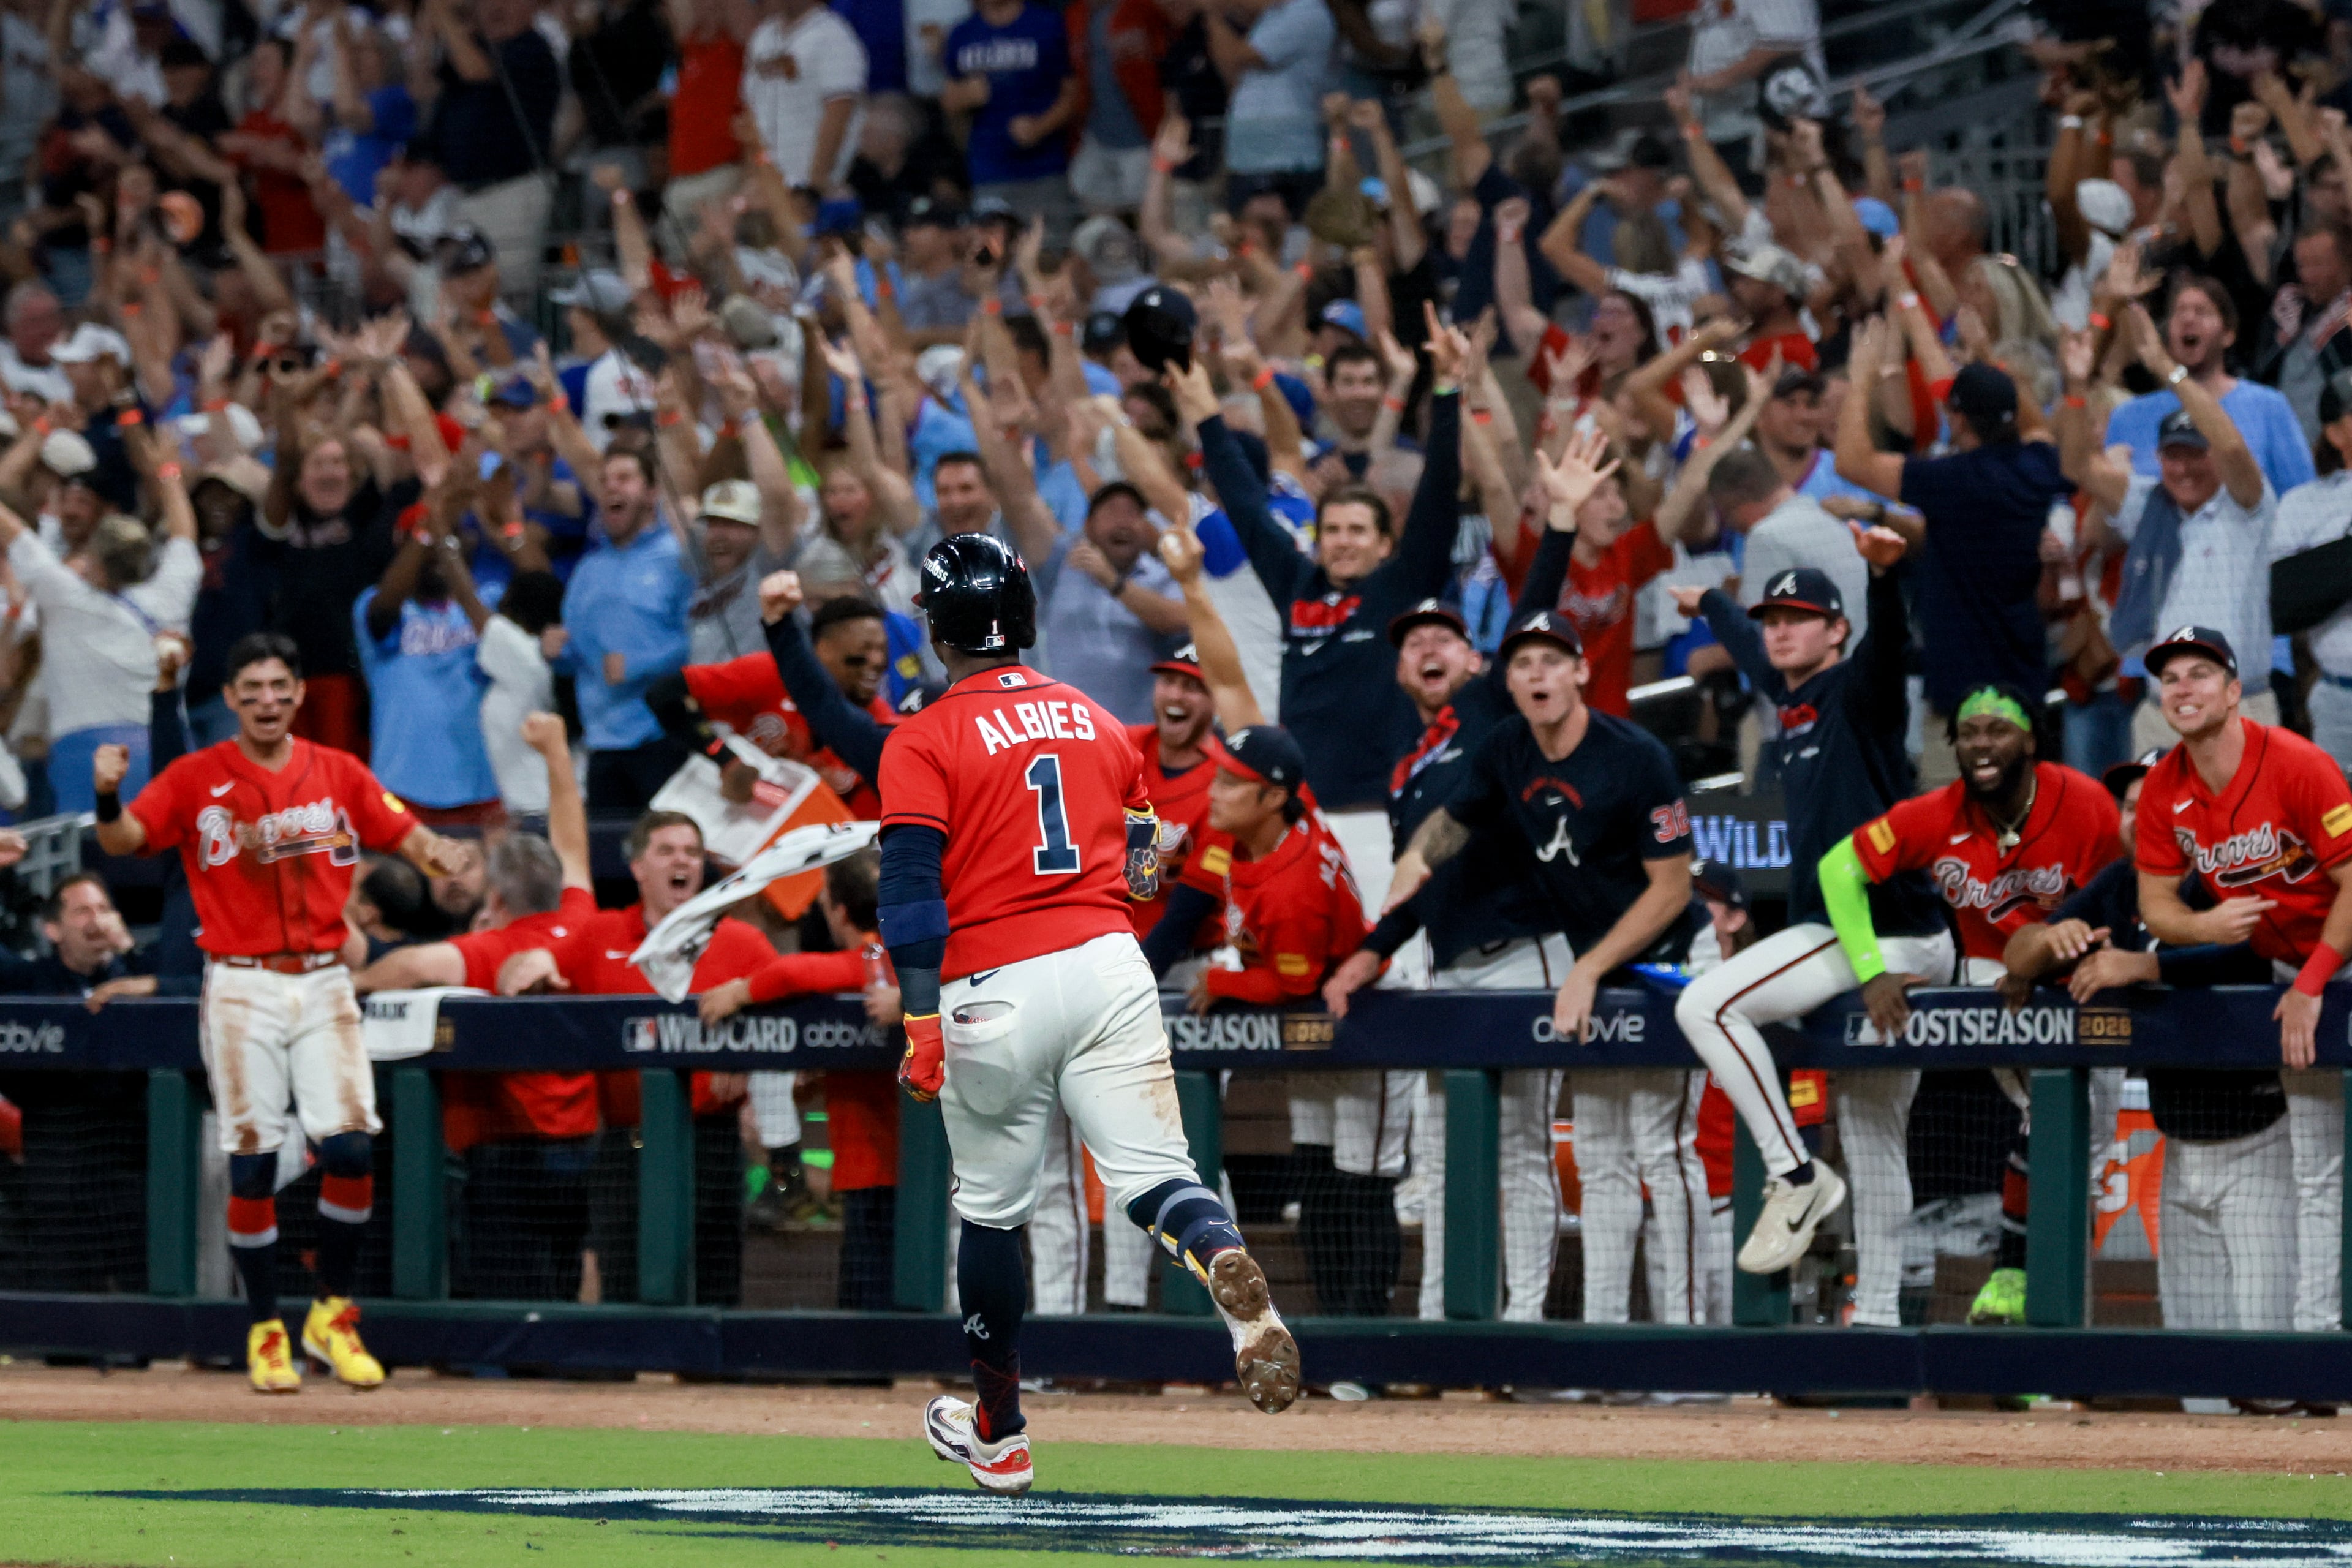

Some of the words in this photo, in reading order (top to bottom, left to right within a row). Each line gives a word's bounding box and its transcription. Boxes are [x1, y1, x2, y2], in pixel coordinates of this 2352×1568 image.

[992, 620, 998, 635] 1
[974, 701, 1096, 756] ALBIES
[196, 797, 334, 872] Braves
[1025, 753, 1081, 875] 1
[1536, 815, 1580, 867] A
[1690, 816, 1792, 869] WILD
[1933, 856, 2064, 909] Braves
[1532, 1009, 1645, 1043] avie
